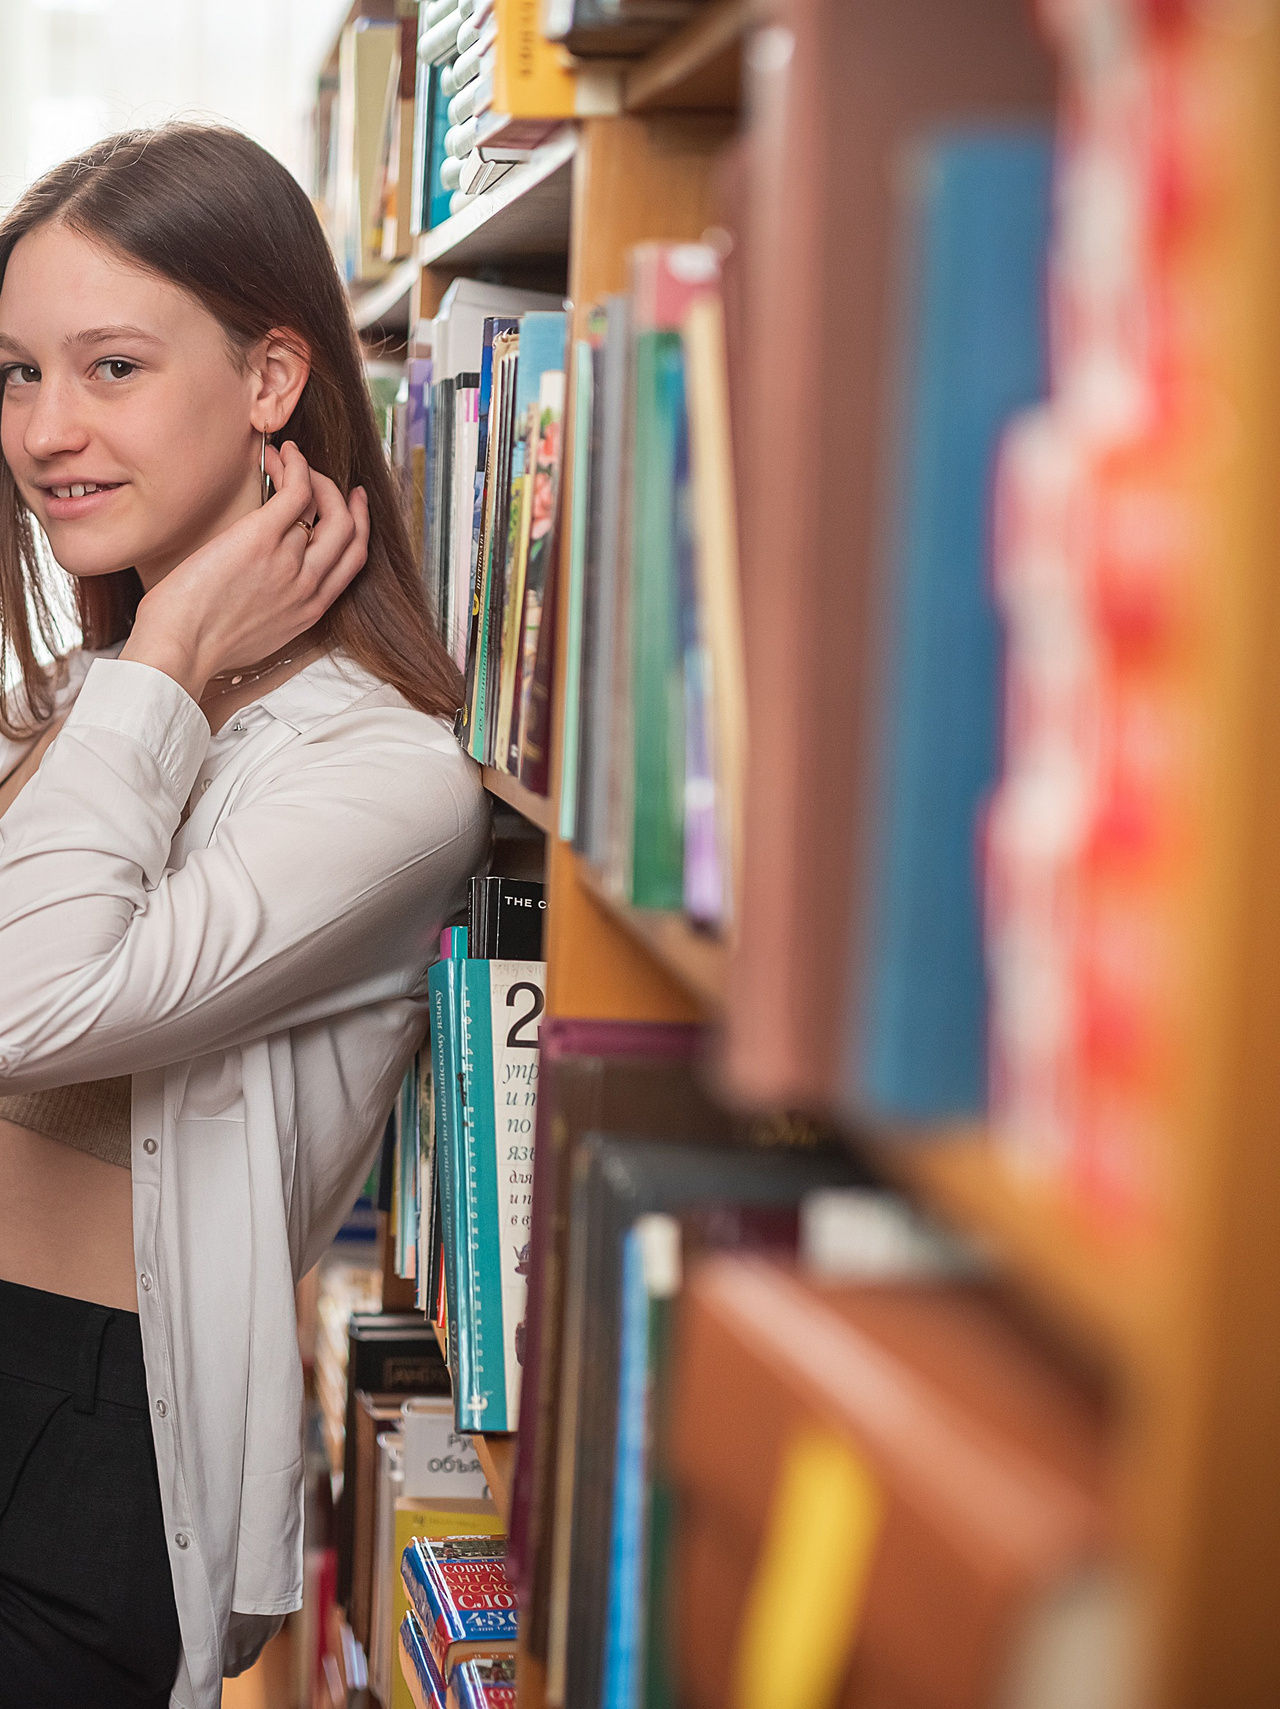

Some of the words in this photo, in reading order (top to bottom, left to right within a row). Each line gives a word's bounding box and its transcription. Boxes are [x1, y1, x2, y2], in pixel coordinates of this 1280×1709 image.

[476, 533, 485, 590] DICTIONARY
[504, 895, 533, 908] THE
[537, 900, 551, 910] C
[435, 989, 444, 1030] языку
[505, 981, 546, 1049] 2
[437, 1033, 447, 1122] английскому
[502, 1062, 539, 1085] упр
[505, 1091, 518, 1106] и
[441, 1125, 448, 1142] по
[507, 1118, 531, 1134] по
[509, 1169, 533, 1184] для
[510, 1193, 519, 1205] и
[510, 1215, 518, 1226] в
[458, 1593, 519, 1609] СЛО
[488, 1688, 517, 1700] СО
